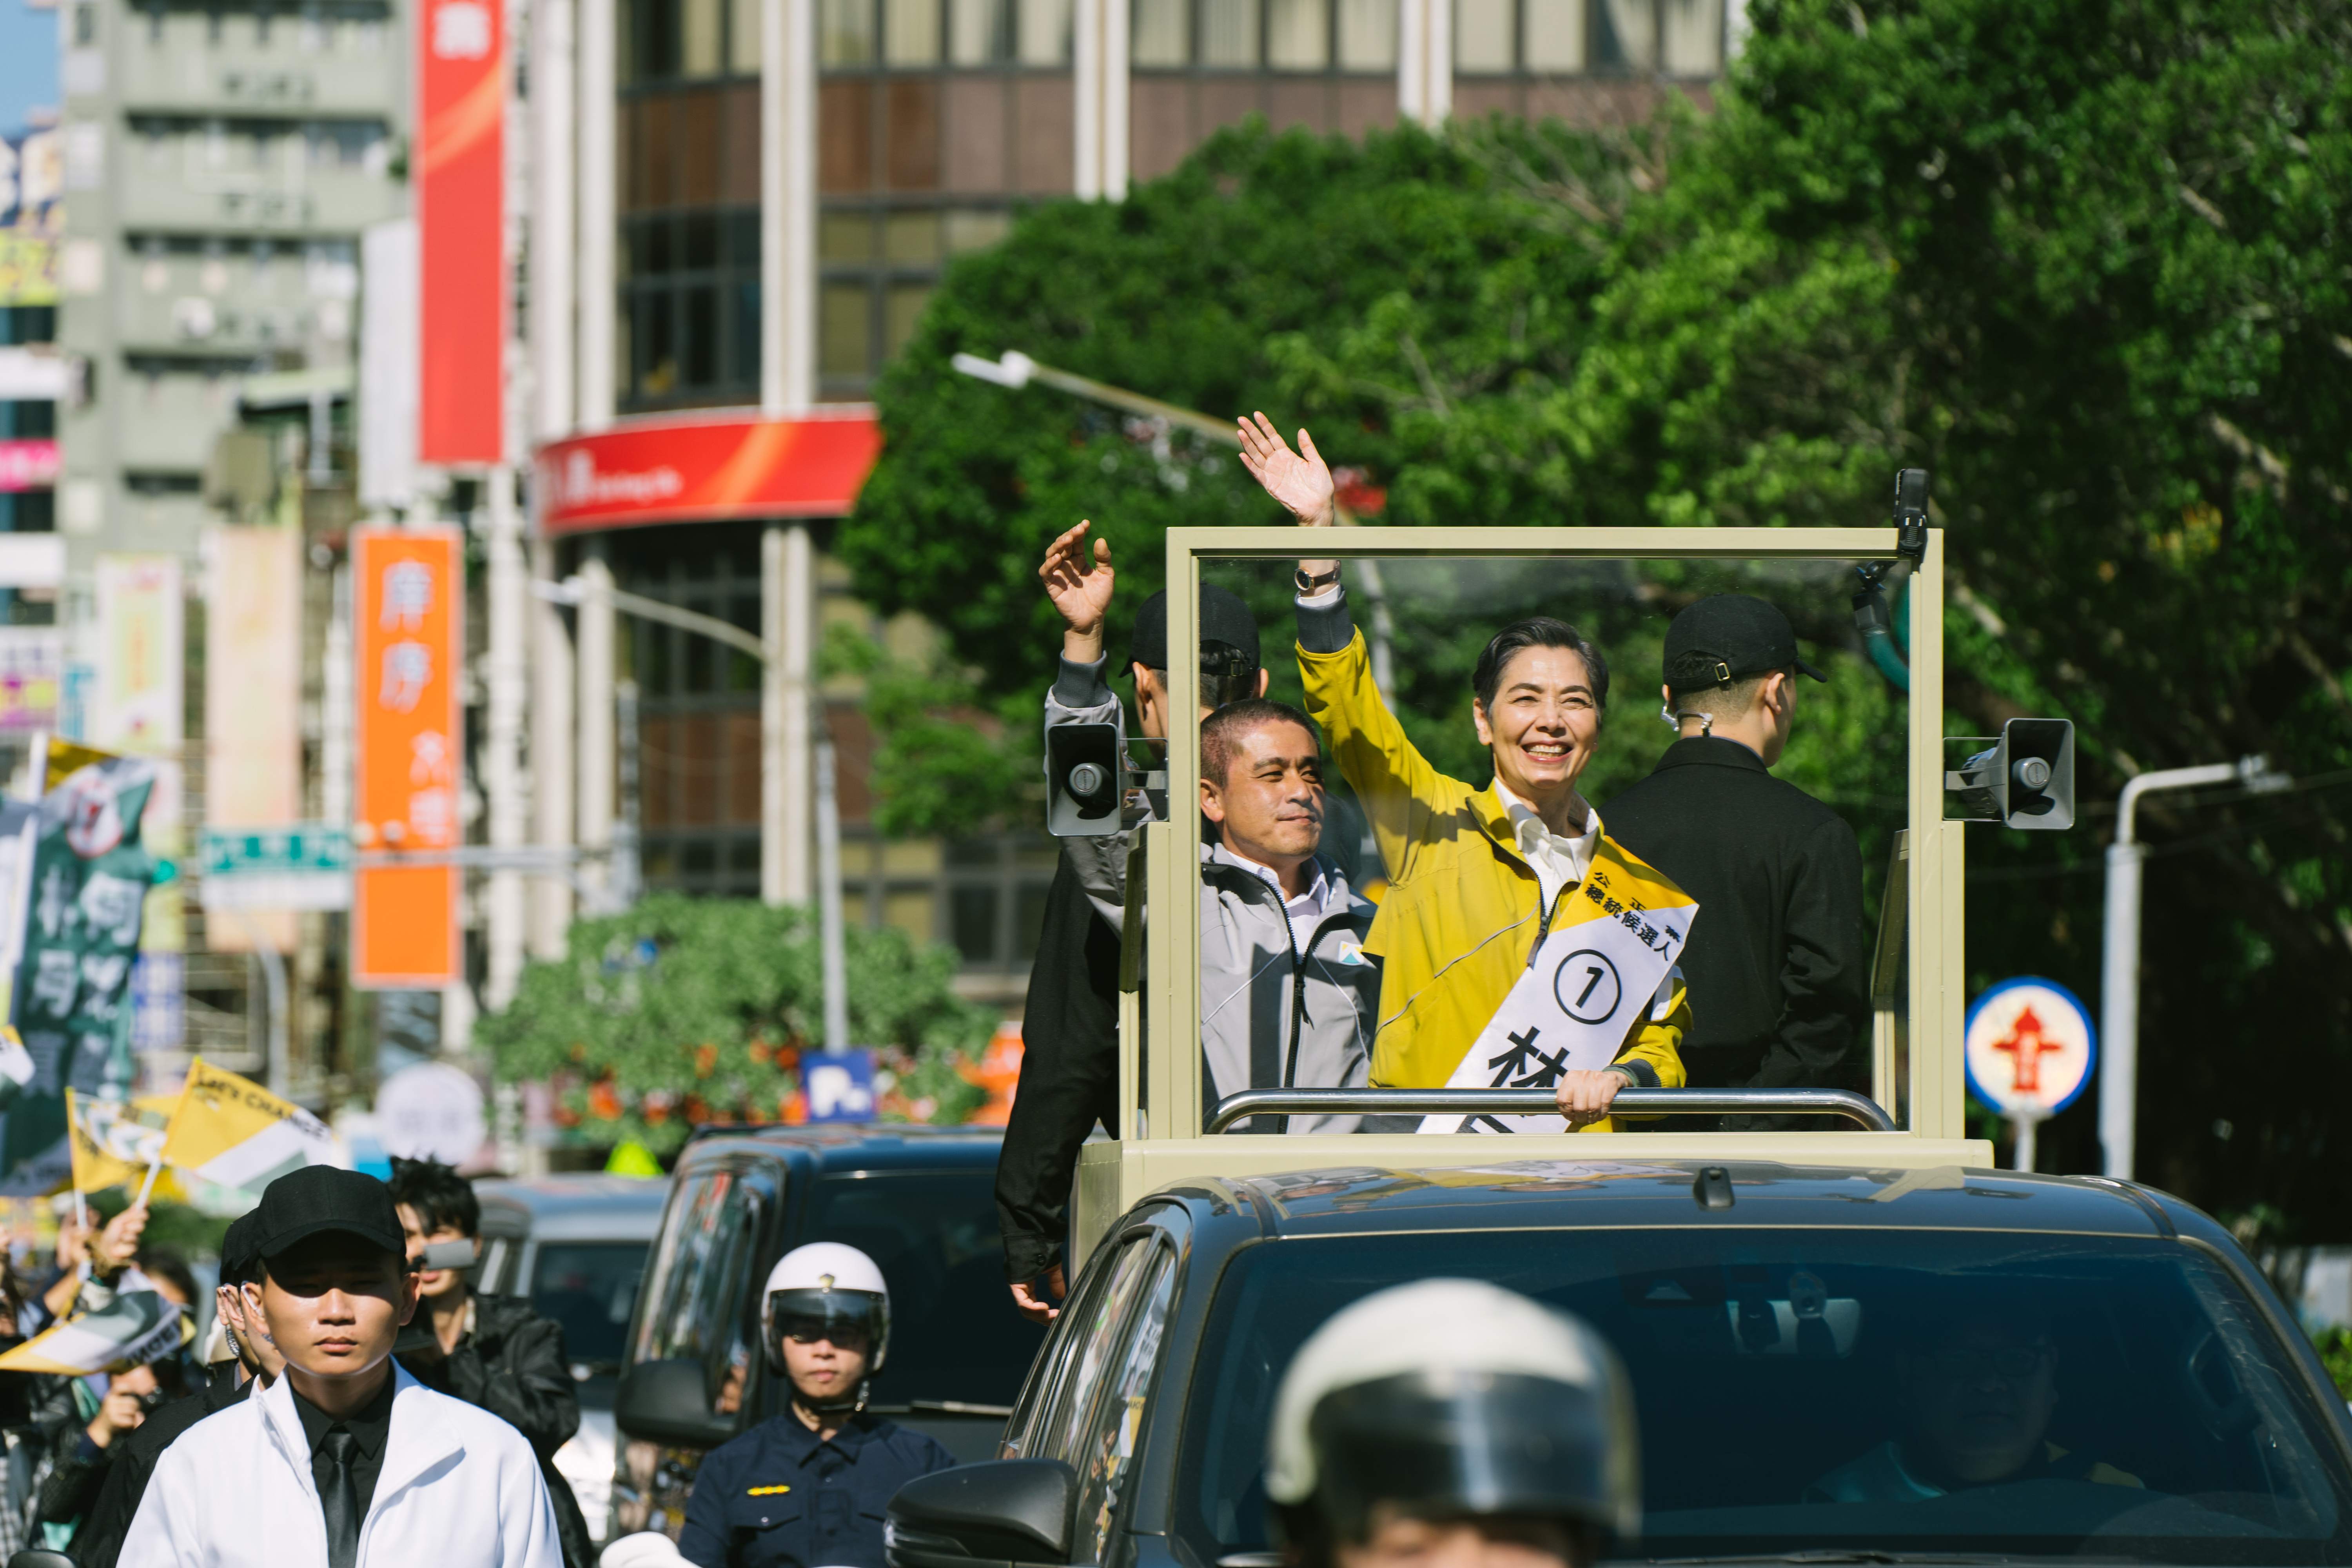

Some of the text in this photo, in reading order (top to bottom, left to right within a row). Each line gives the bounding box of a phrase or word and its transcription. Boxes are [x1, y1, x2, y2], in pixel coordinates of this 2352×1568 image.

[1585, 884, 1670, 961] 總統候選人
